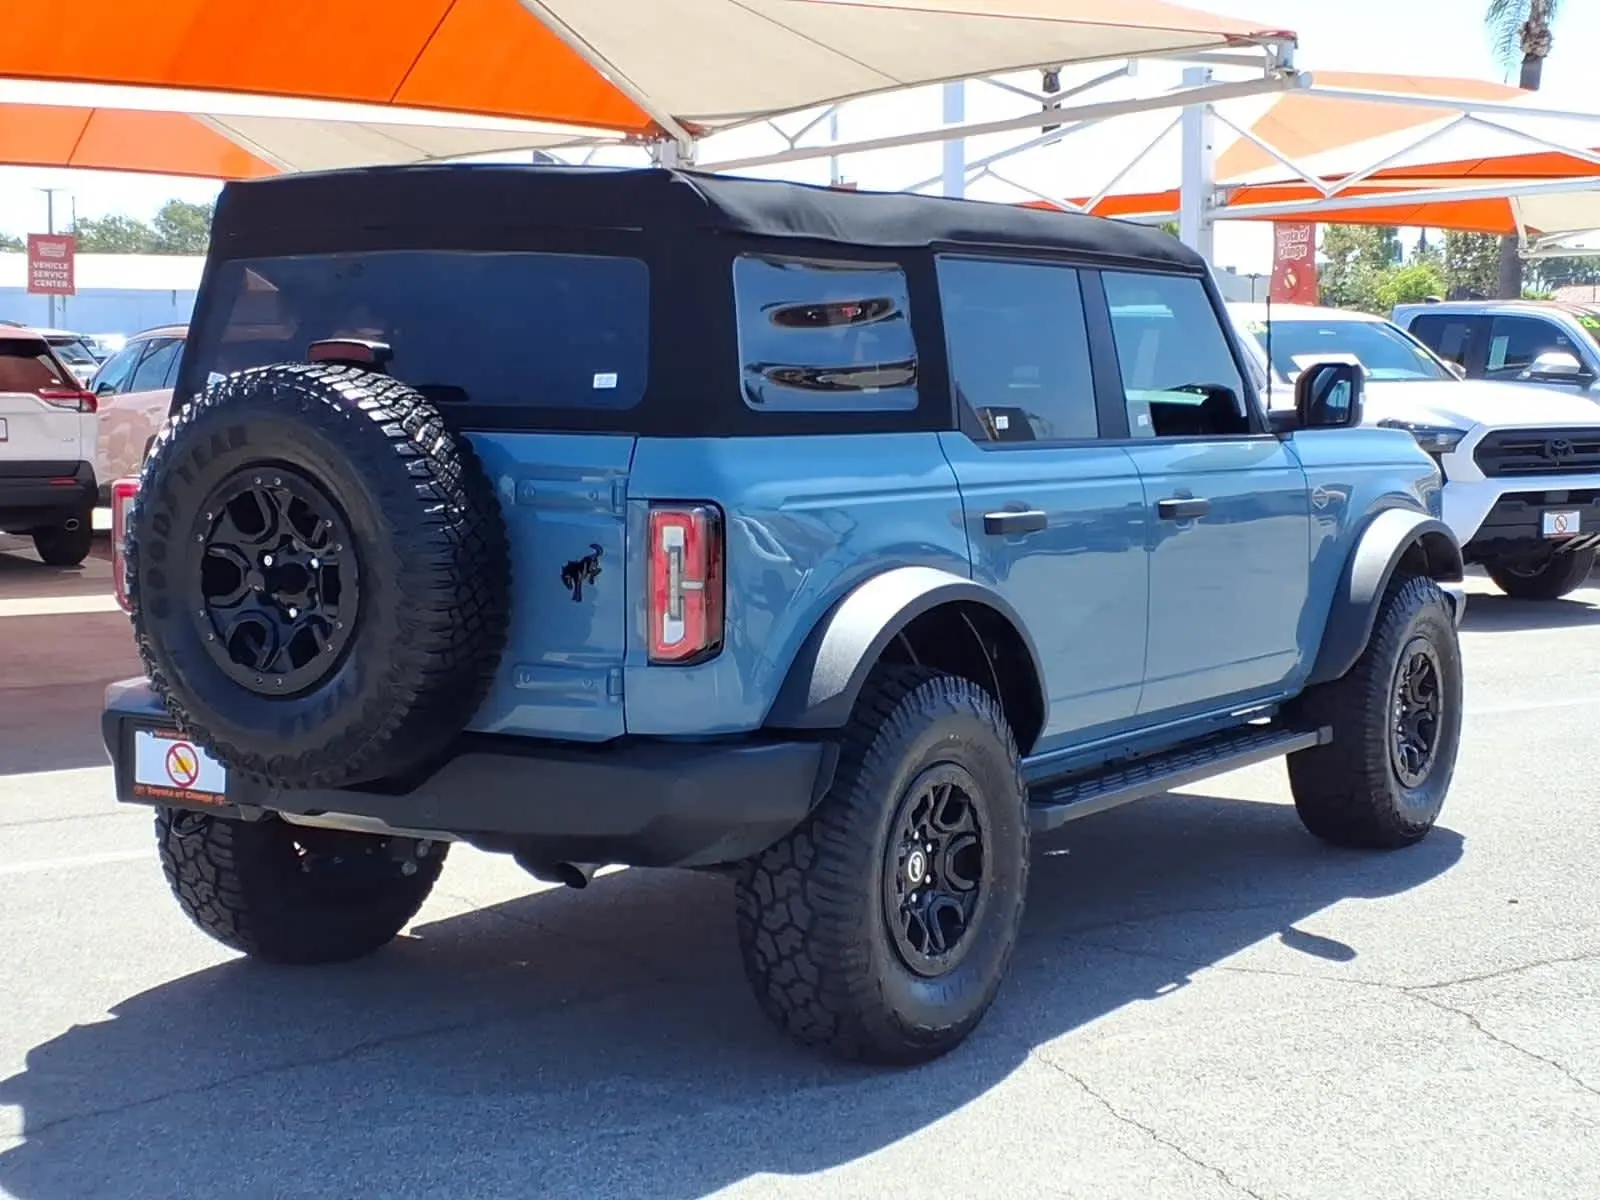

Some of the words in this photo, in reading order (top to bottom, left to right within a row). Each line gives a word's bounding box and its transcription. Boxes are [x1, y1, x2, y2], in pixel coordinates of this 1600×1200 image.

[32, 261, 69, 270] VEHICLE
[33, 270, 68, 279] SERVICE
[34, 279, 68, 288] CENTER
